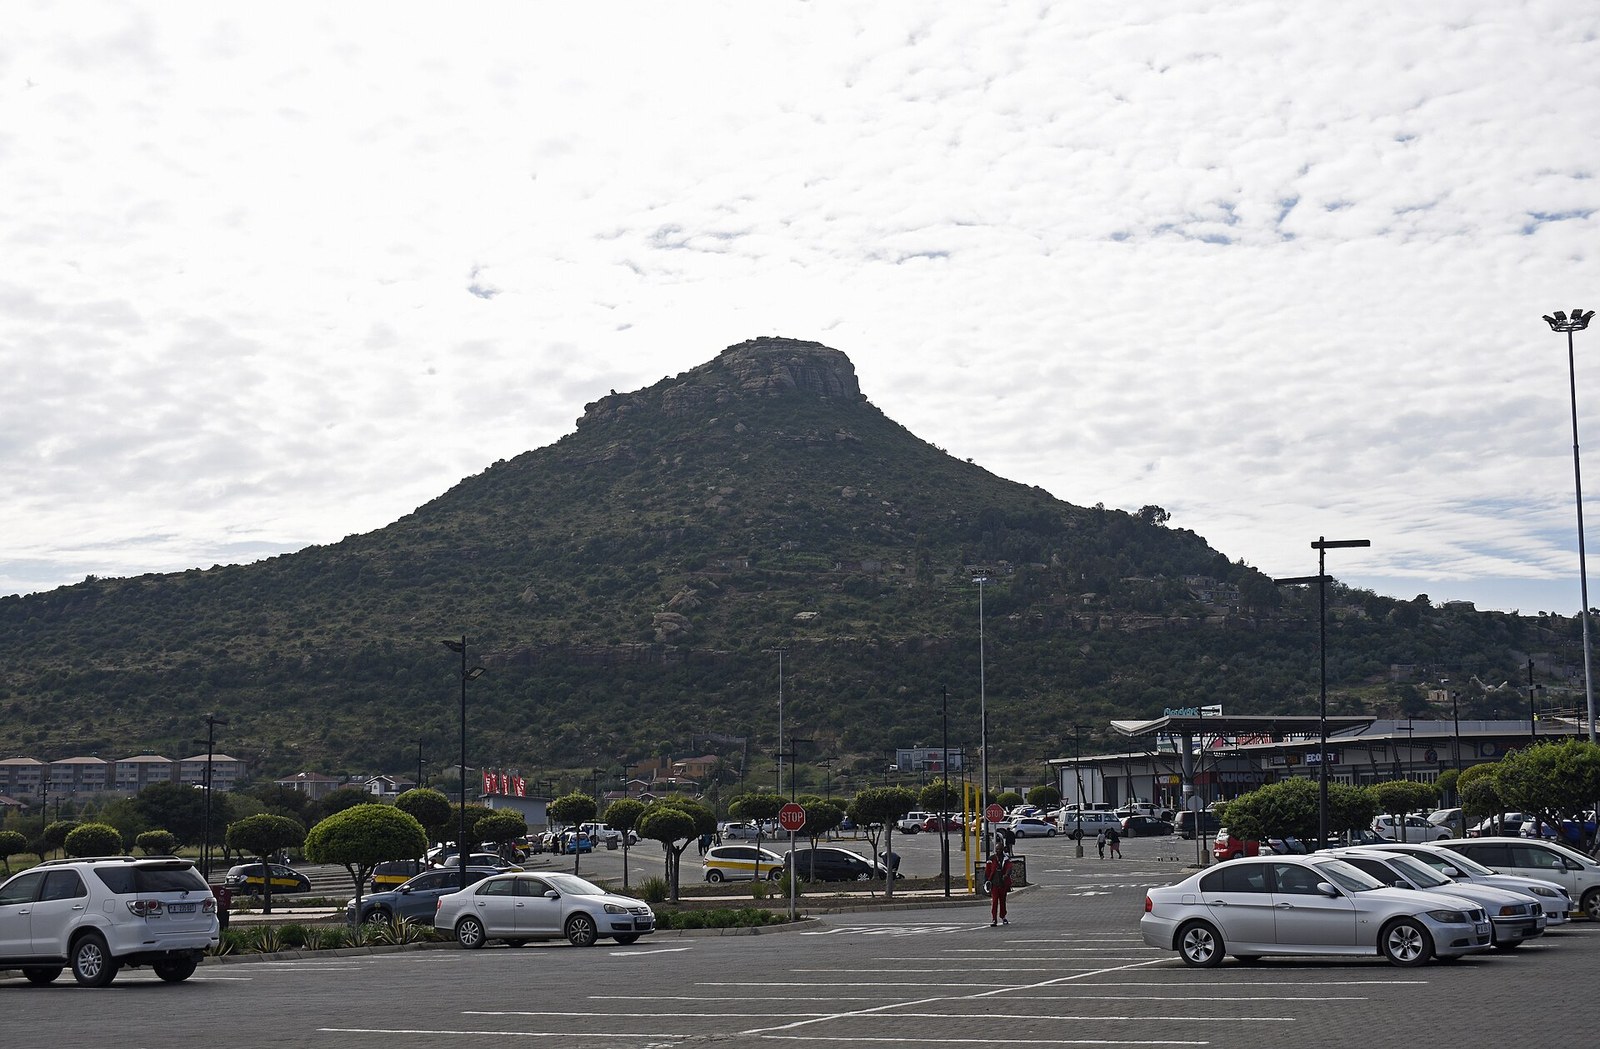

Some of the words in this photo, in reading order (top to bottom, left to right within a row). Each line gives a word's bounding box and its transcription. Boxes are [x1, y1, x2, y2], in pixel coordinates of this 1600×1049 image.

[1306, 753, 1336, 763] ECOET
[781, 811, 803, 823] STOP
[986, 809, 1003, 818] STOP
